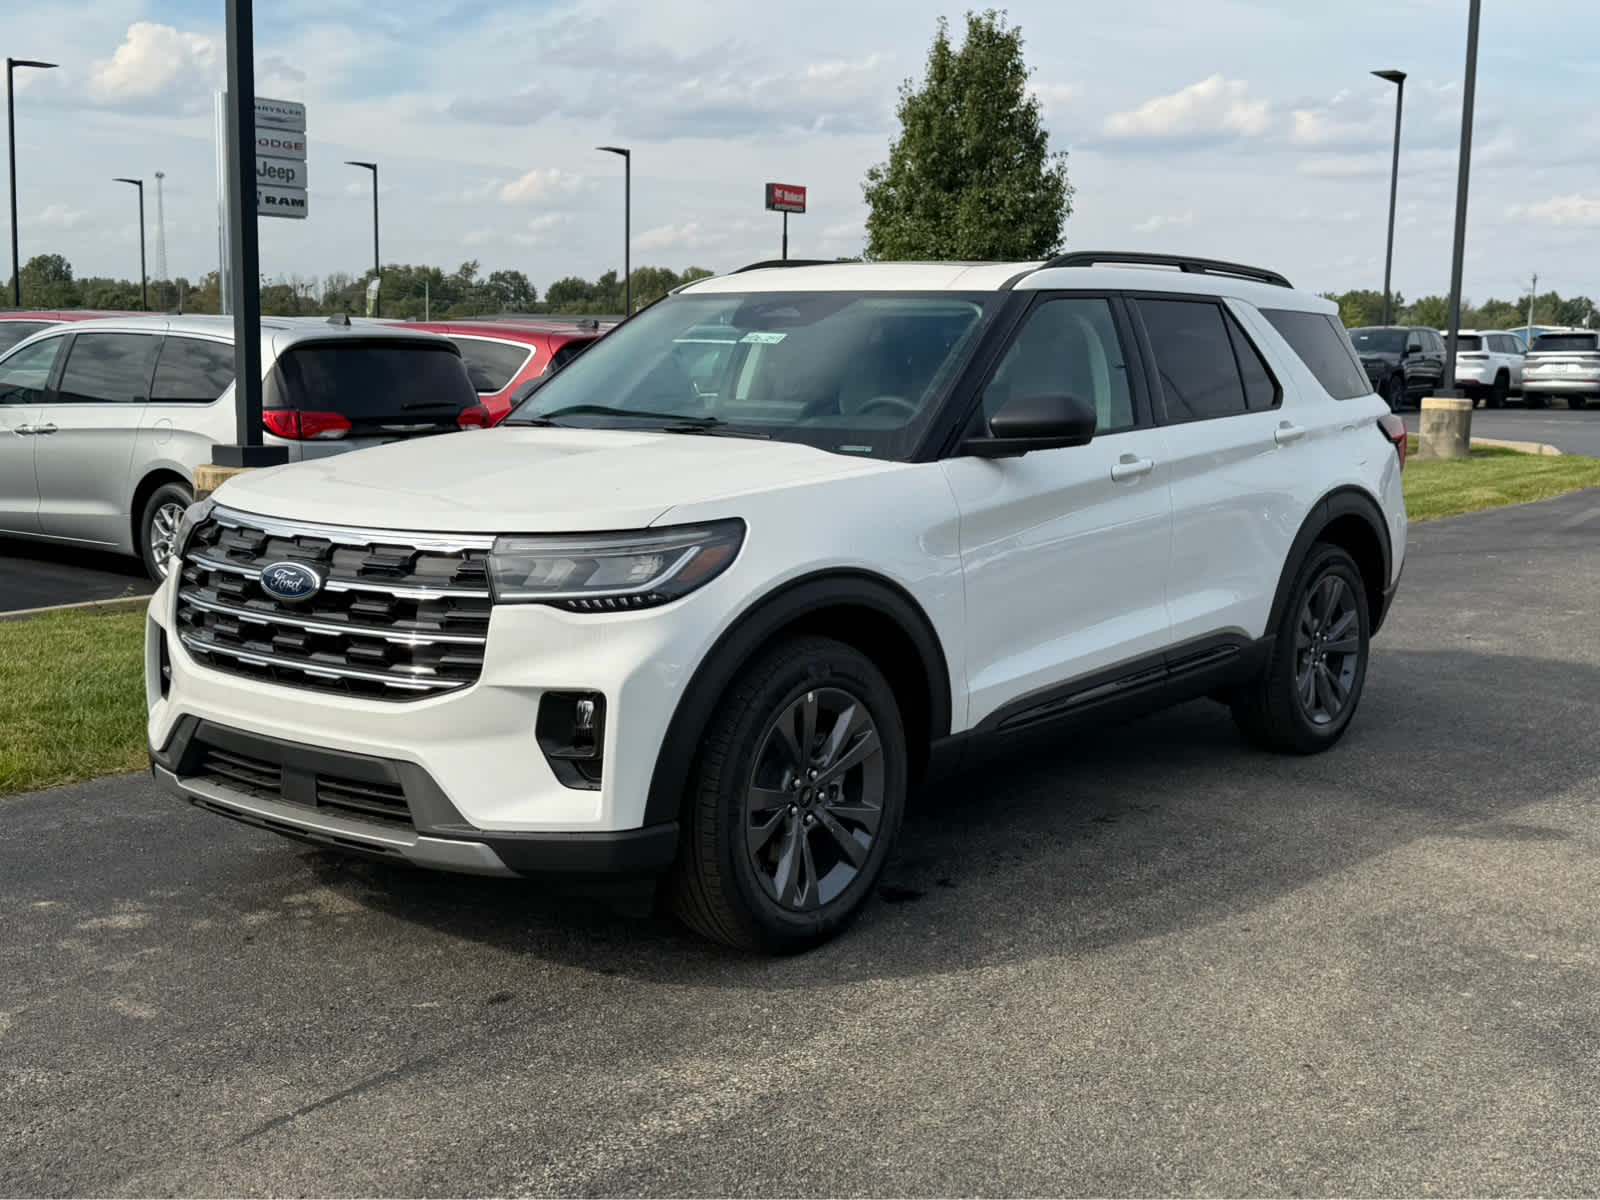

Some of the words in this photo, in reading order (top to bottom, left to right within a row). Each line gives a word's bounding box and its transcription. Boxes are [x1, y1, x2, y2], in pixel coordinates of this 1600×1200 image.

[254, 105, 302, 116] HRYSLER
[258, 138, 304, 151] ODGE
[256, 161, 295, 183] Jeep
[265, 195, 305, 208] RAM
[270, 568, 304, 592] Ford
